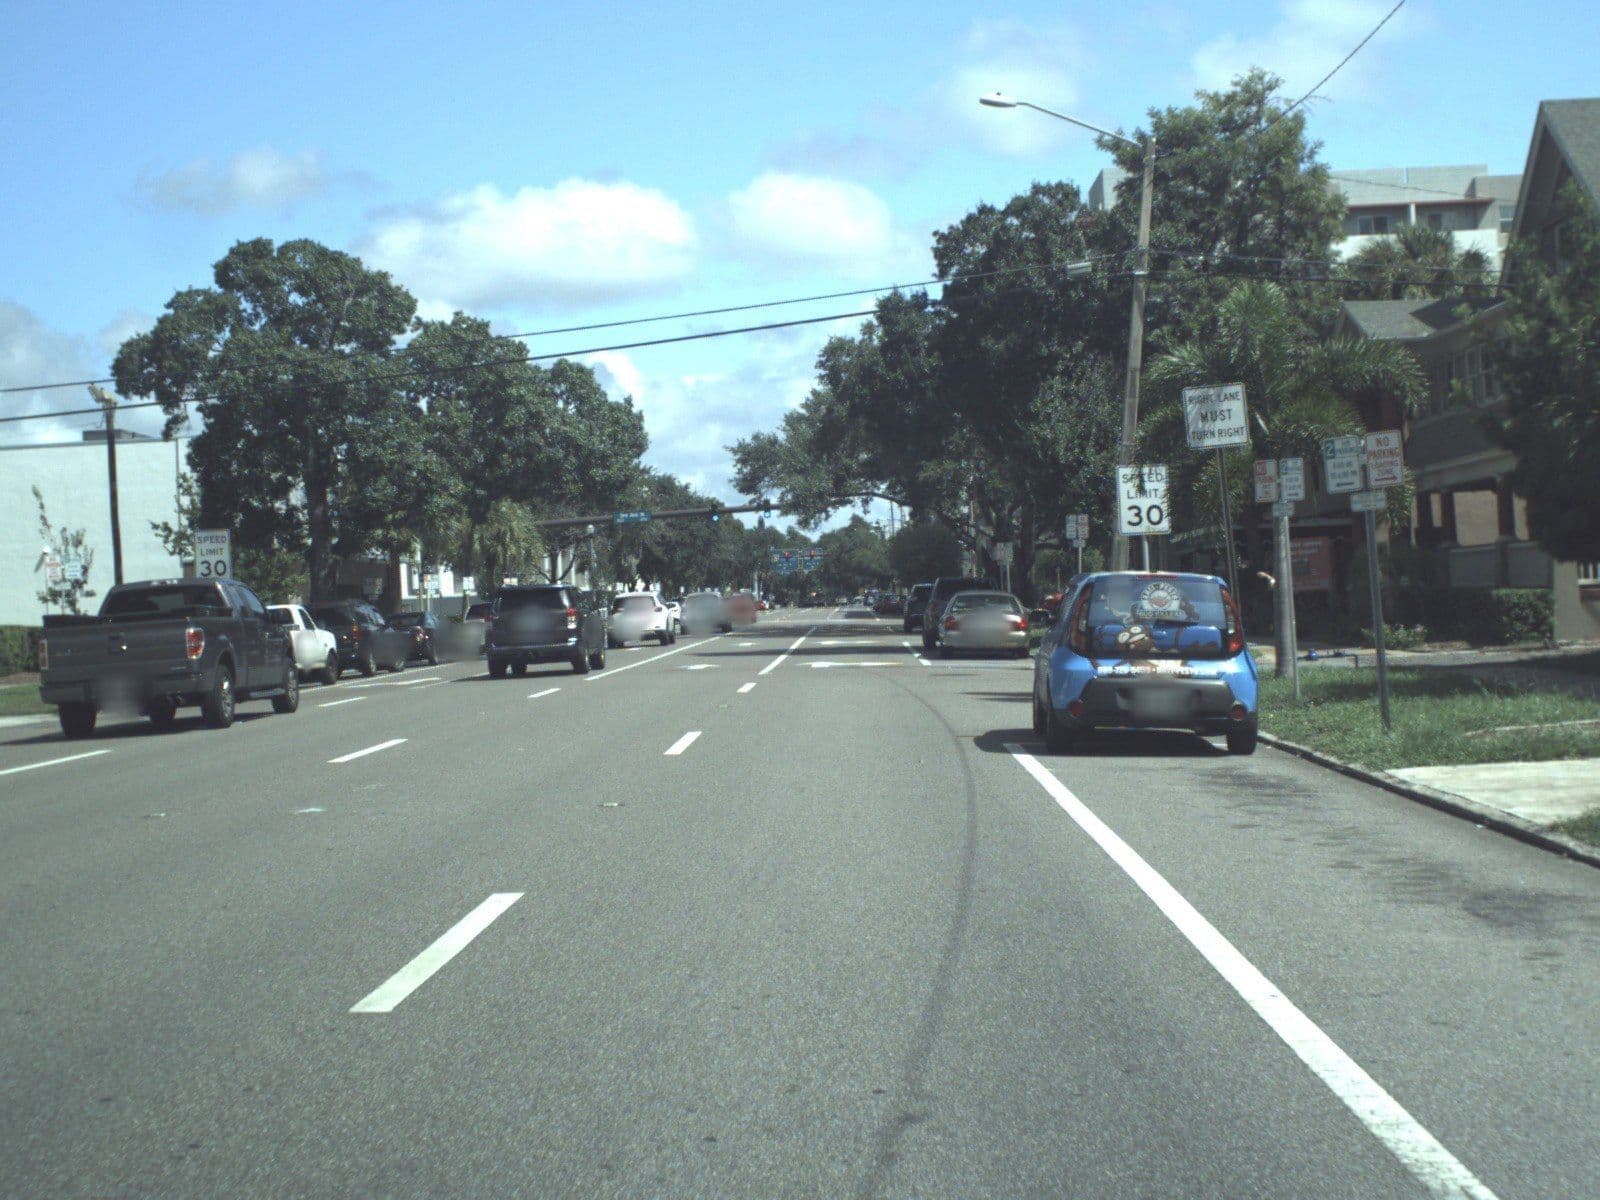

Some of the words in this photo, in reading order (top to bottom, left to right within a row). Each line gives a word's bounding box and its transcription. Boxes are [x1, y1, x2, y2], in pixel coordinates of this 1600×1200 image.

[1187, 393, 1214, 405] RIGHT
[1217, 391, 1241, 403] LANE
[1200, 408, 1233, 423] MUST
[1191, 429, 1216, 442] TURN
[1217, 426, 1245, 438] RIGHT
[1375, 435, 1390, 447] NO
[1126, 504, 1164, 527] 30
[196, 535, 227, 544] SPEED
[200, 547, 224, 557] LIMIT
[200, 560, 227, 577] 30
